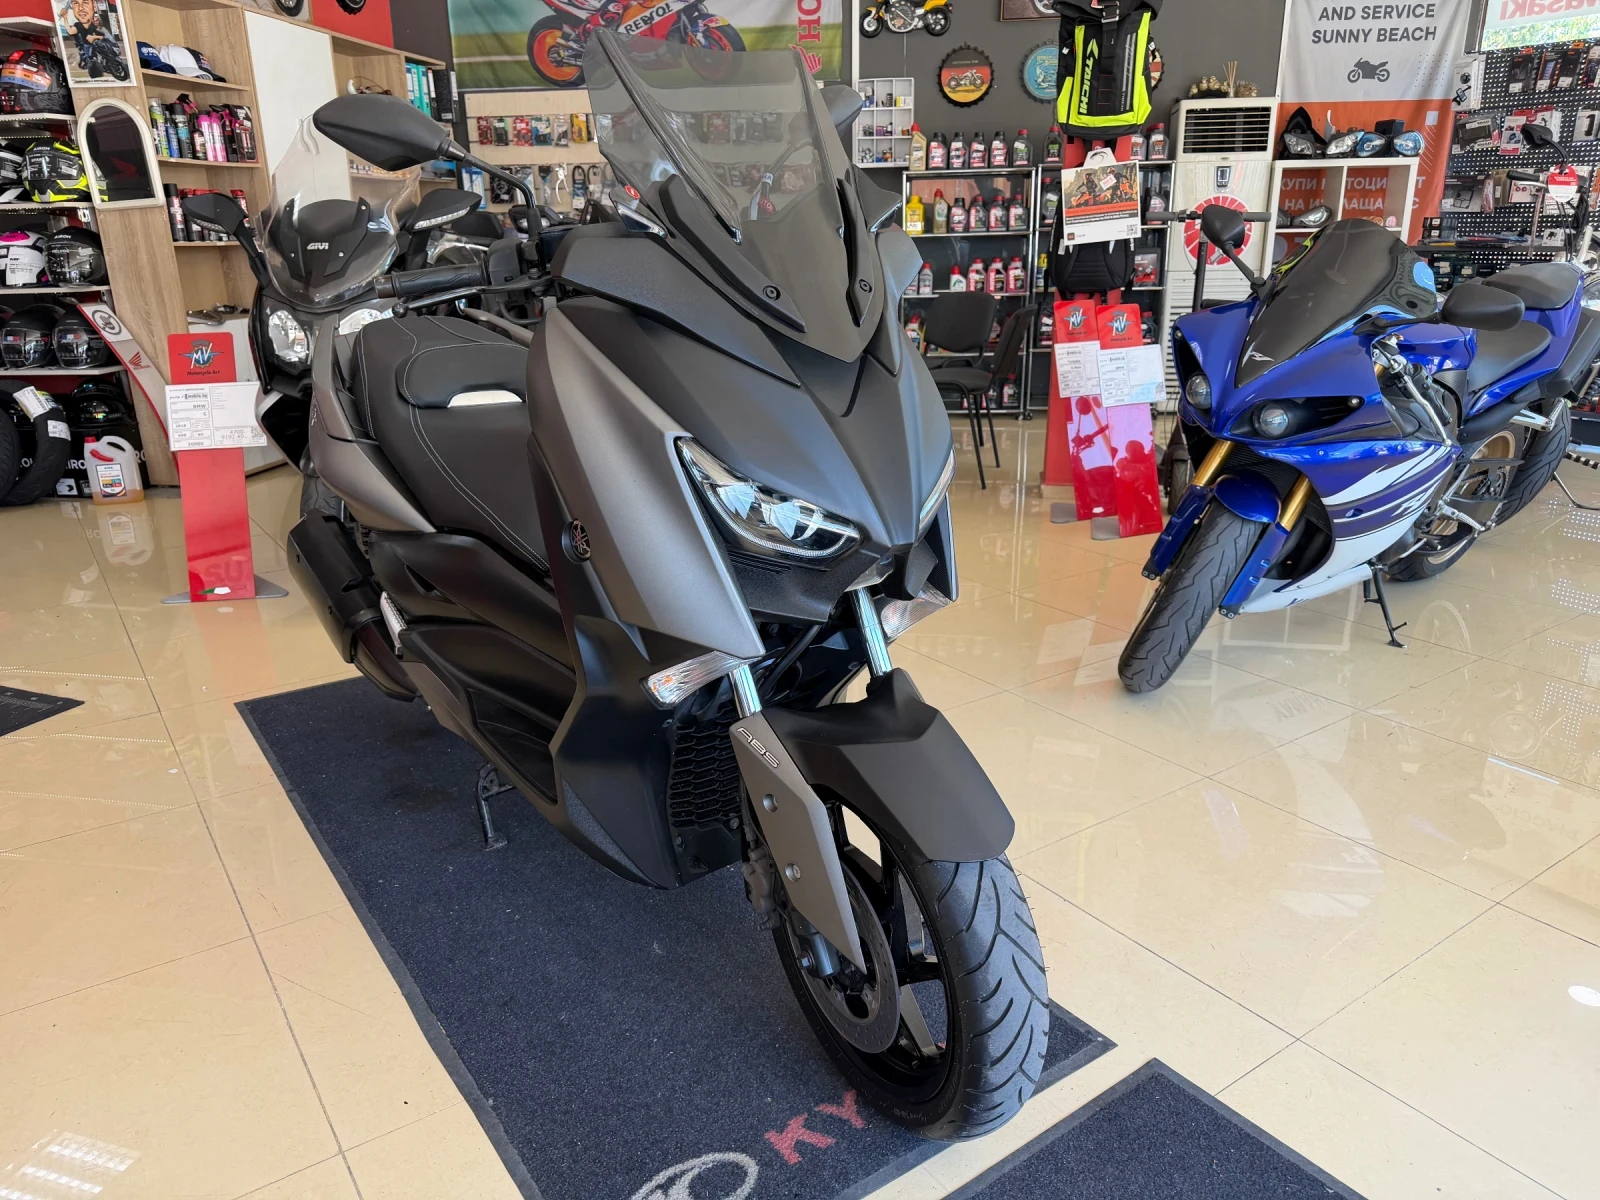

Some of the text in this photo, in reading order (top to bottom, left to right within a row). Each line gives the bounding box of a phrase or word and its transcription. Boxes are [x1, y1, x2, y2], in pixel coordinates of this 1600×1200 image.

[798, 0, 822, 43] HO
[1318, 4, 1436, 21] AND SERVICE
[1311, 26, 1437, 44] SUNNY BEACH
[1079, 57, 1094, 114] TAICHI
[1285, 198, 1305, 211] НА
[1069, 308, 1083, 331] MV
[1113, 313, 1127, 336] MV
[191, 343, 213, 369] MV
[736, 726, 780, 768] ABS
[764, 1089, 866, 1164] KY
